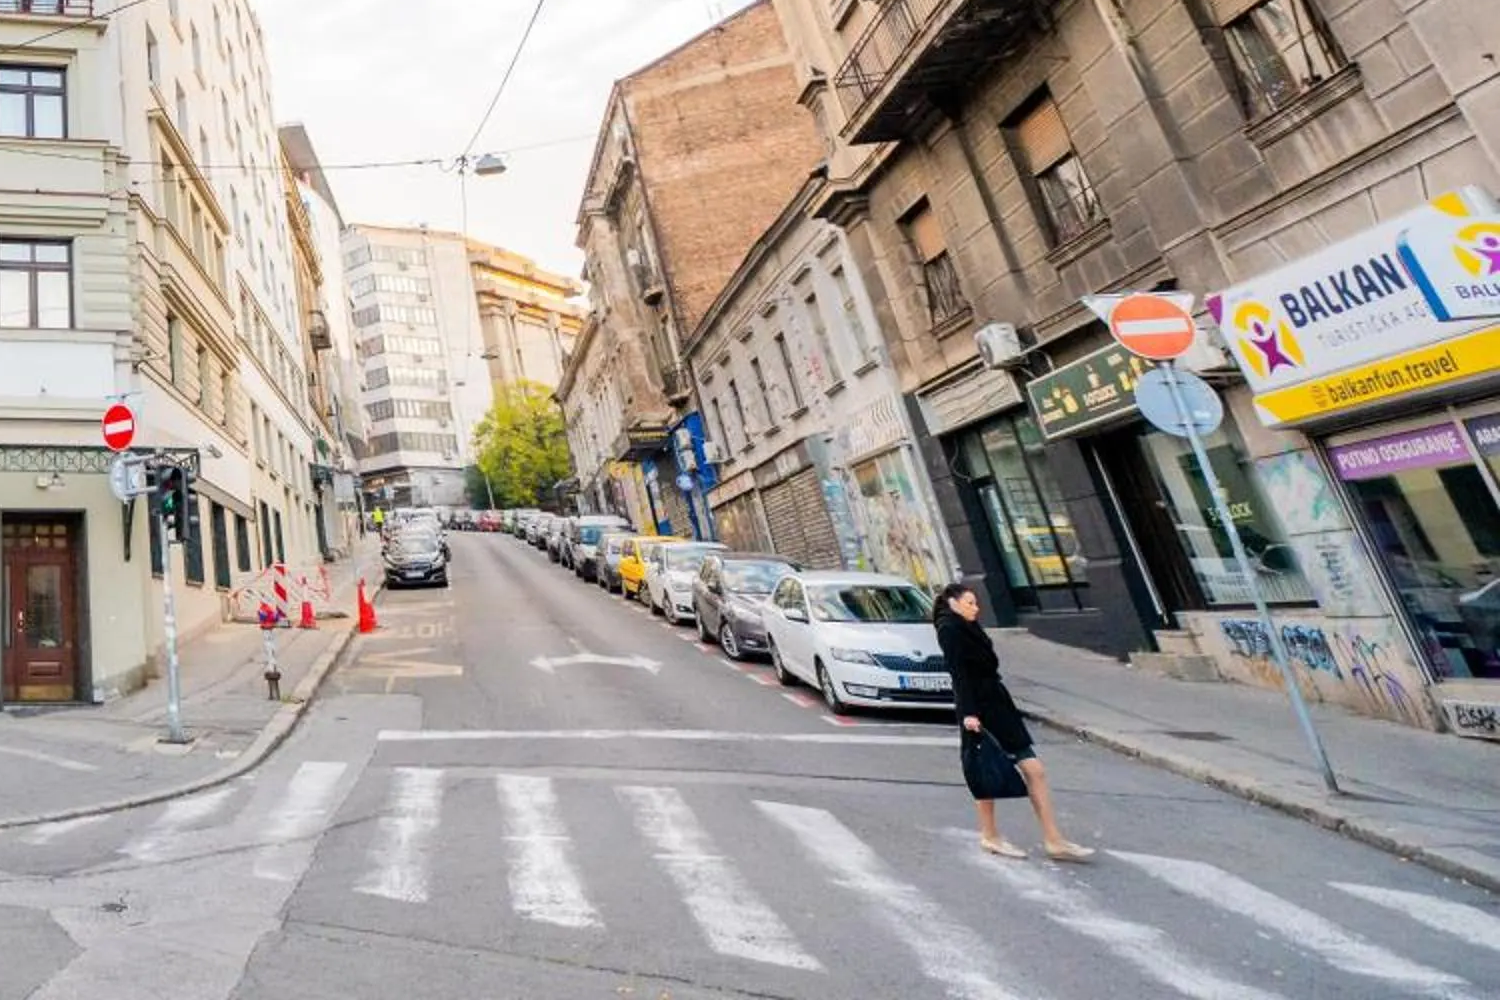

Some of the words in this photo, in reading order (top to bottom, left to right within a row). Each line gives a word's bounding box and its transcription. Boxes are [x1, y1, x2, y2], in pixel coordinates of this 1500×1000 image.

[1279, 253, 1407, 328] BALKAN
[1328, 350, 1459, 403] balkanfun.travel
[1336, 446, 1380, 471] PUTNO
[1378, 431, 1461, 463] OSIGURANJE
